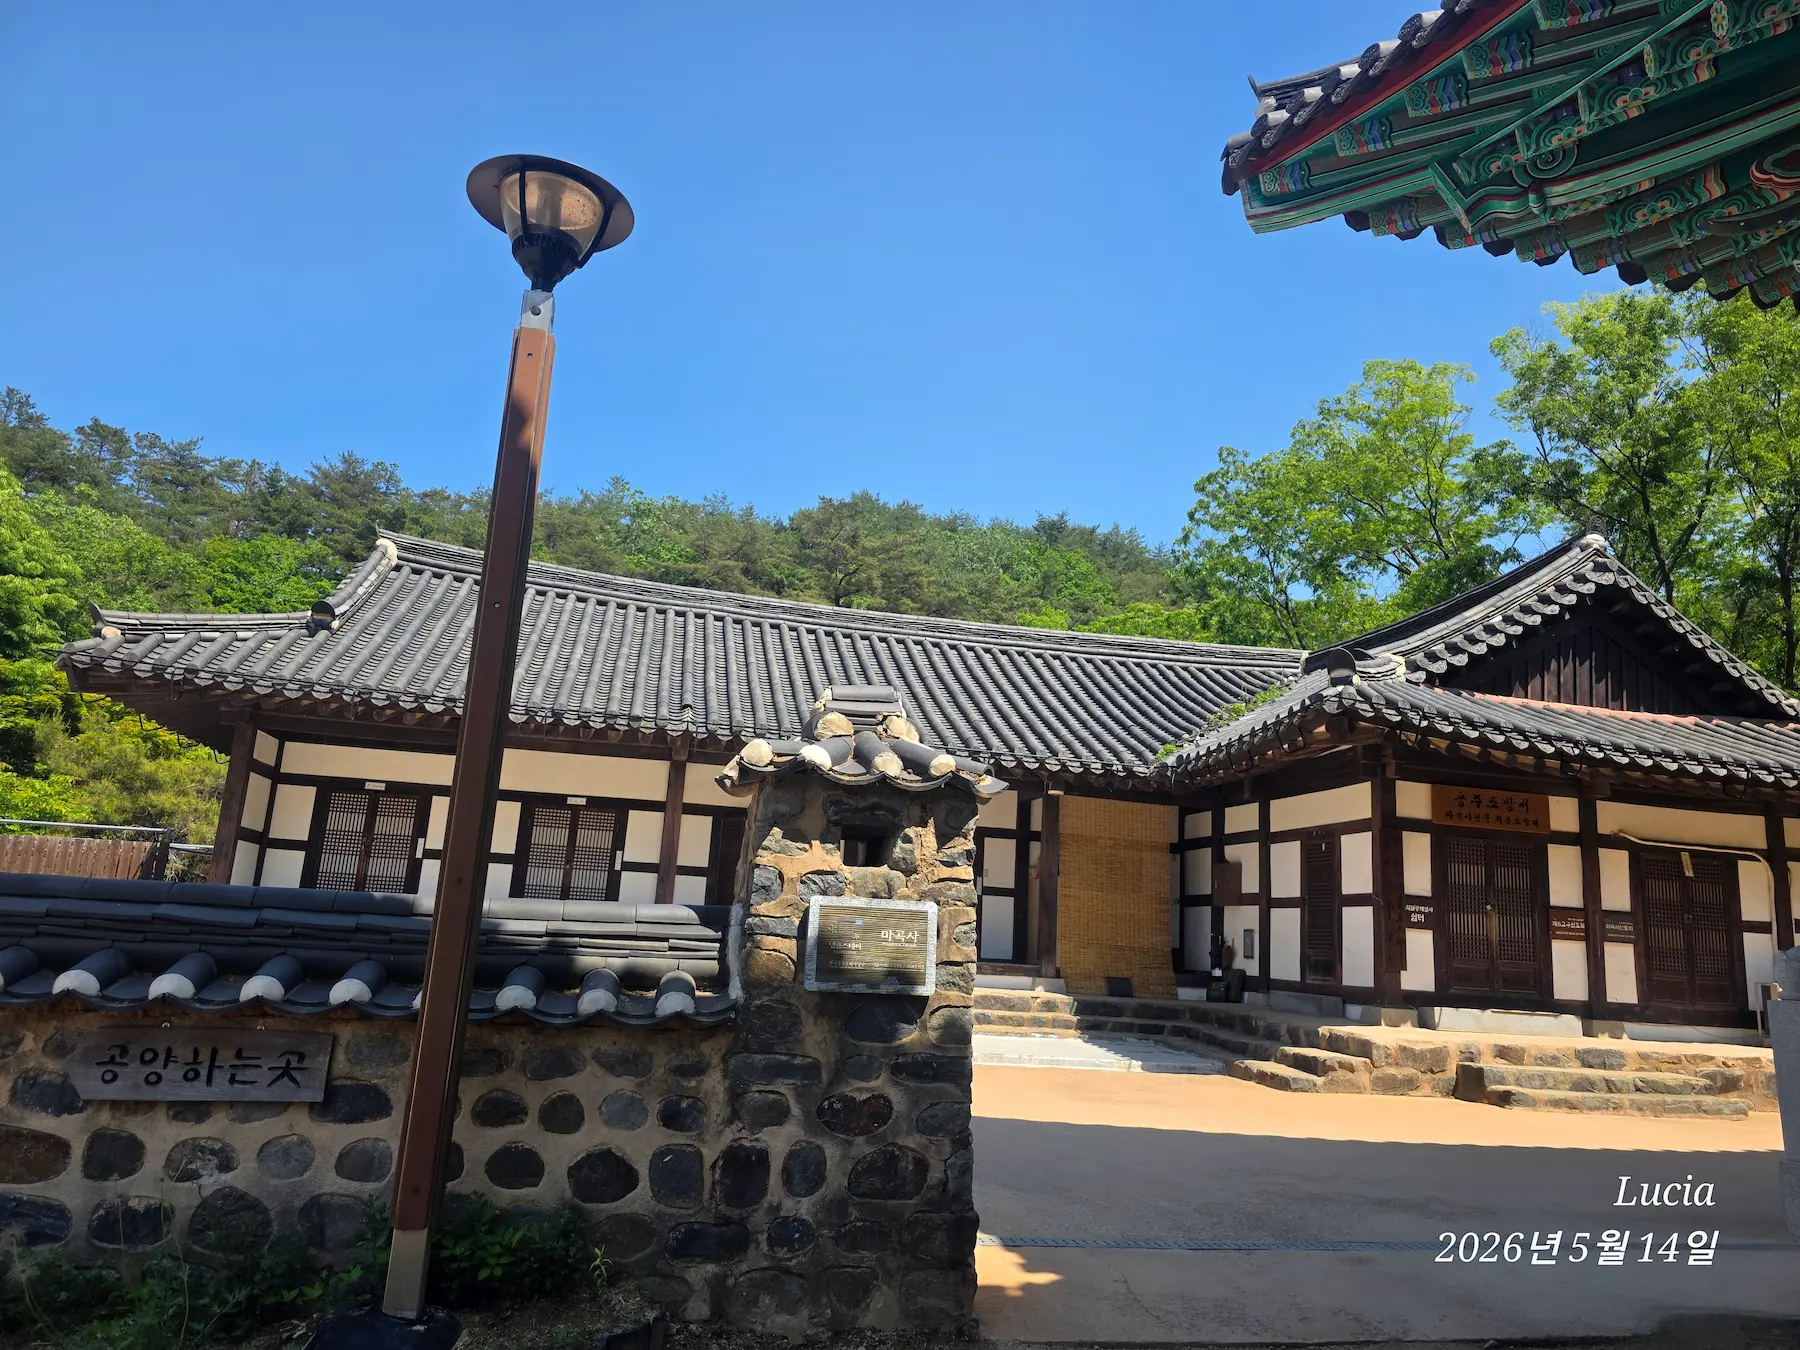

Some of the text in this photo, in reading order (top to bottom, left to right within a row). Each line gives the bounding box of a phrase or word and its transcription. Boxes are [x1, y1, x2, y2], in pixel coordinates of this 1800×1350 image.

[1454, 791, 1530, 814] 공주소방서
[1410, 912, 1425, 923] 쉼터
[880, 929, 920, 943] 마곡사
